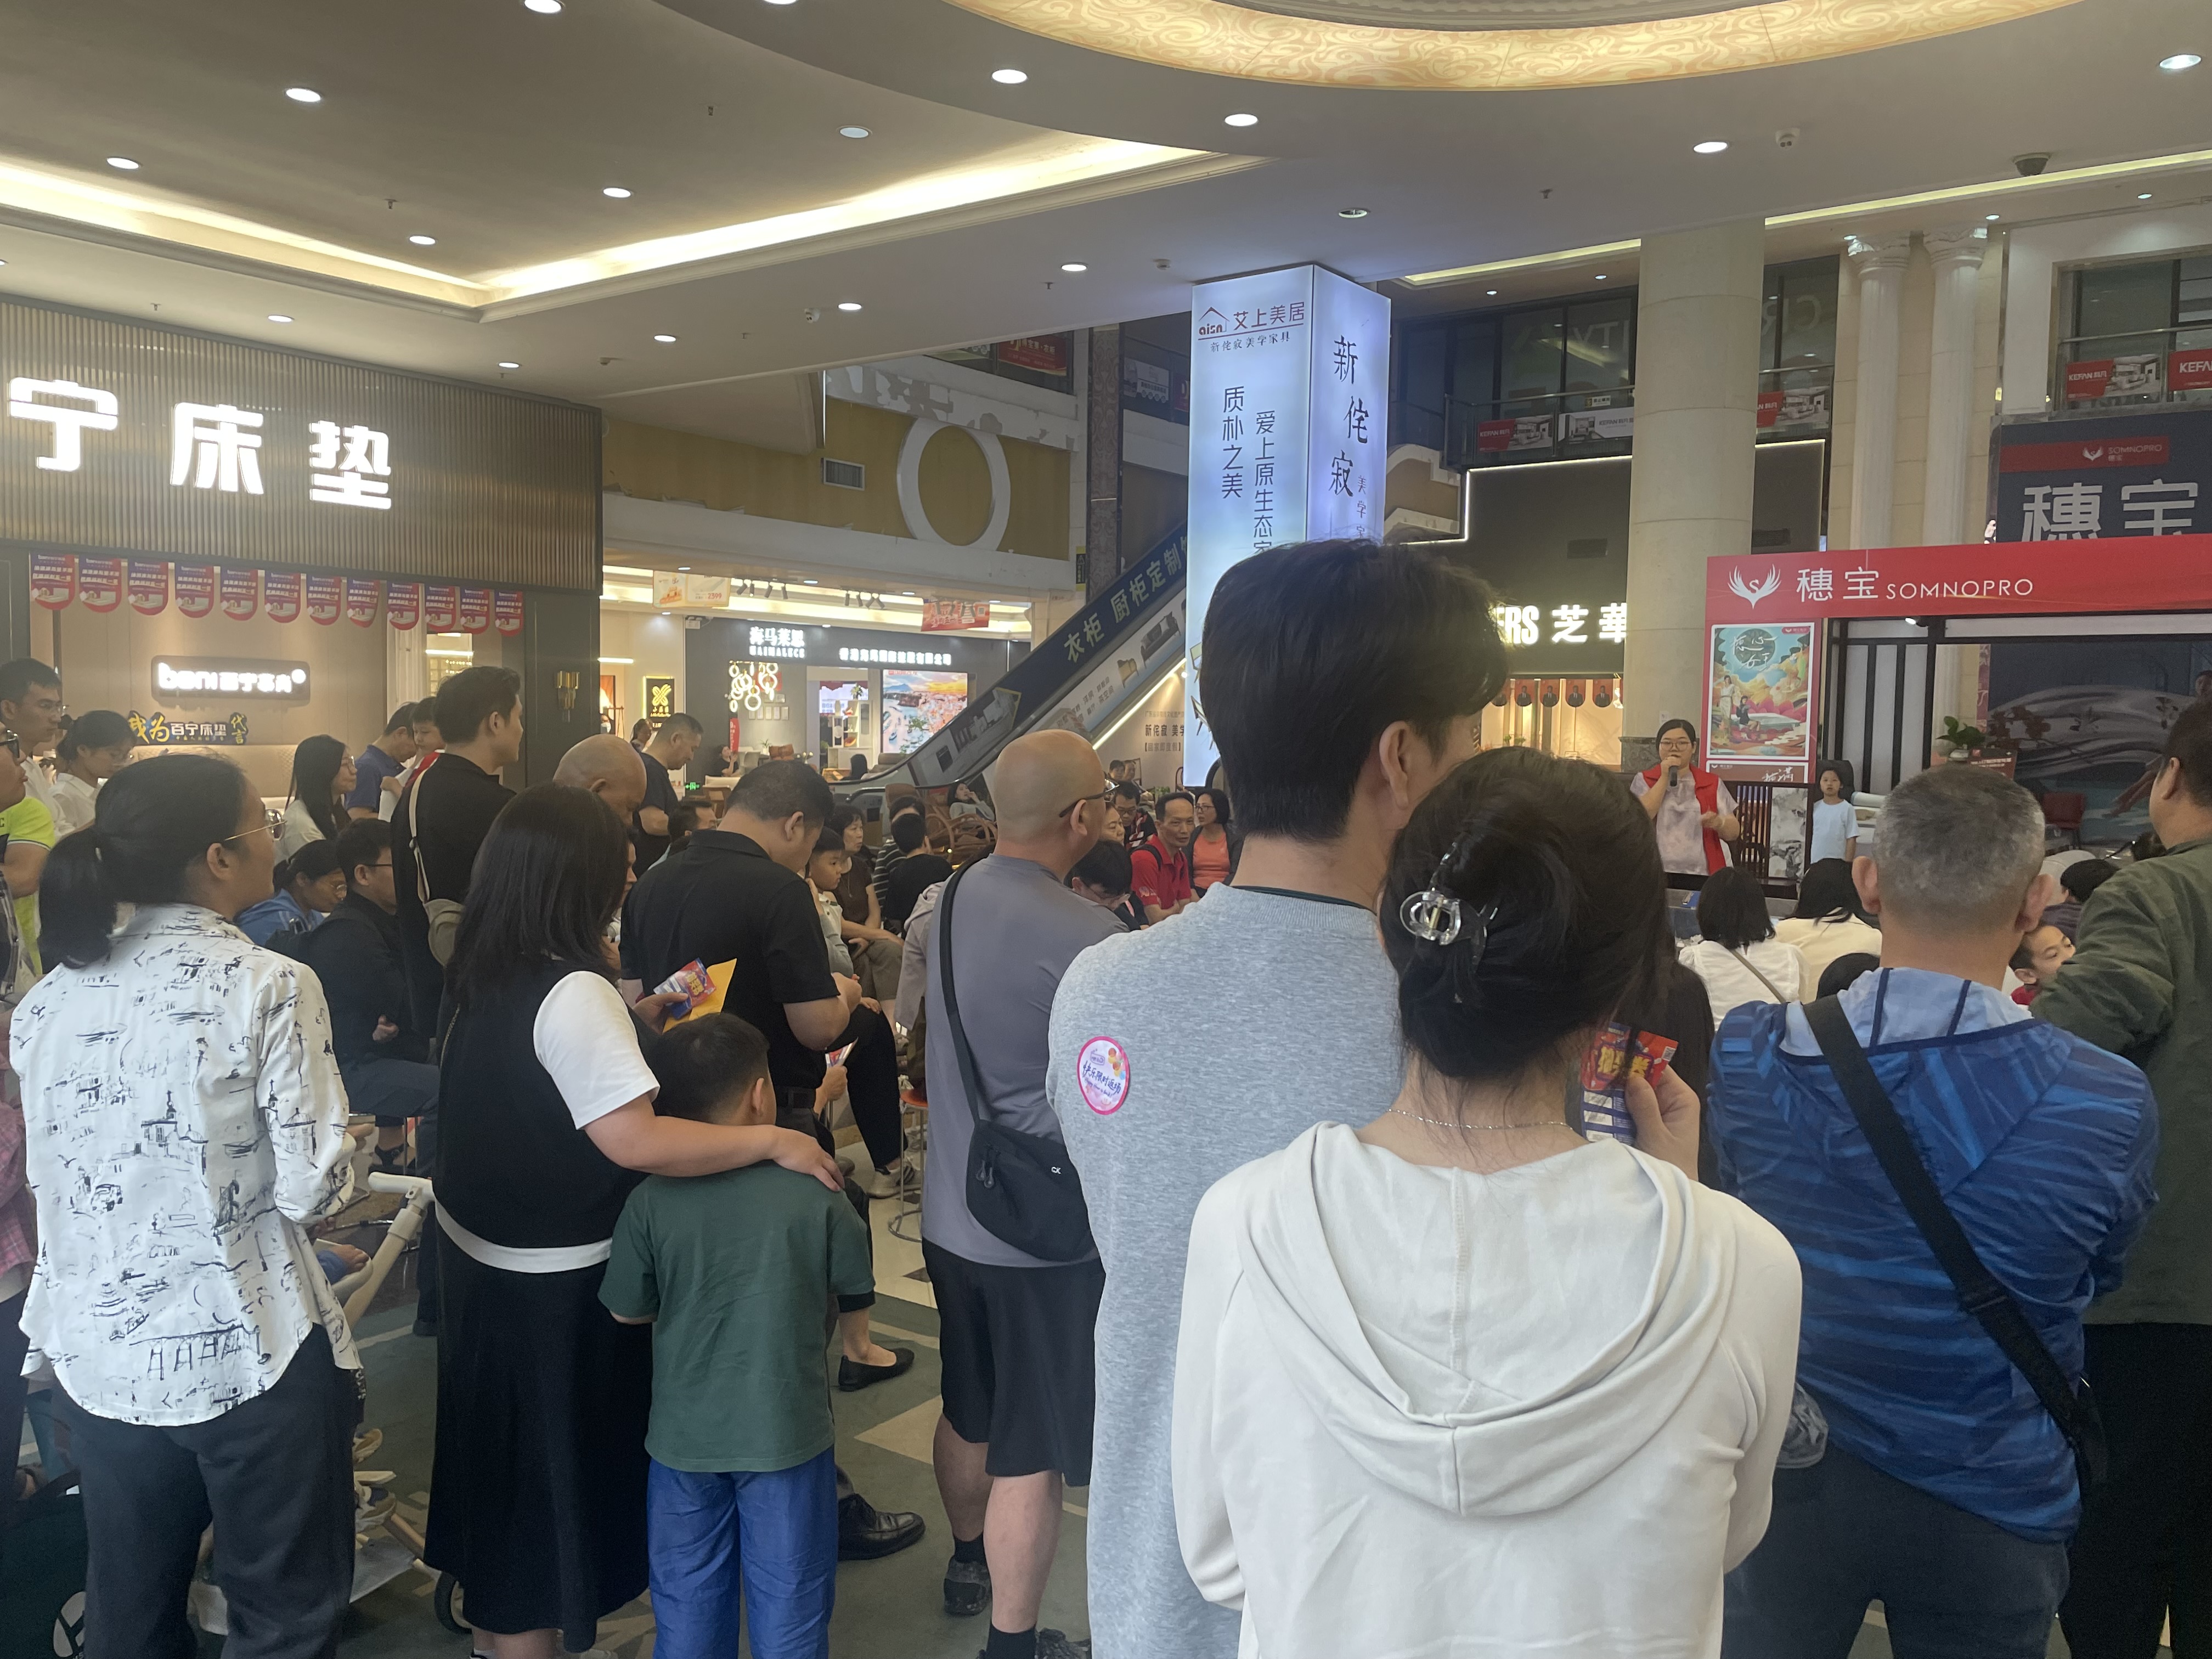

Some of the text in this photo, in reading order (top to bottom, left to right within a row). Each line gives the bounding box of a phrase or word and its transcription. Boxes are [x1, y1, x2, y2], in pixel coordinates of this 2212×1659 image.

[1233, 302, 1305, 331] 艾上美居
[1329, 335, 1369, 497] 新侘寂
[8, 376, 392, 510] 宁床垫
[1222, 386, 1245, 499] 质朴之美
[2108, 444, 2163, 454] SOMNOPRO
[2022, 478, 2198, 541] 穗宝
[1796, 566, 2033, 602] 穗宝 SOMNOPRO
[1064, 612, 1105, 663] 衣柜
[128, 712, 246, 745] 我为 百宁床垫 代言
